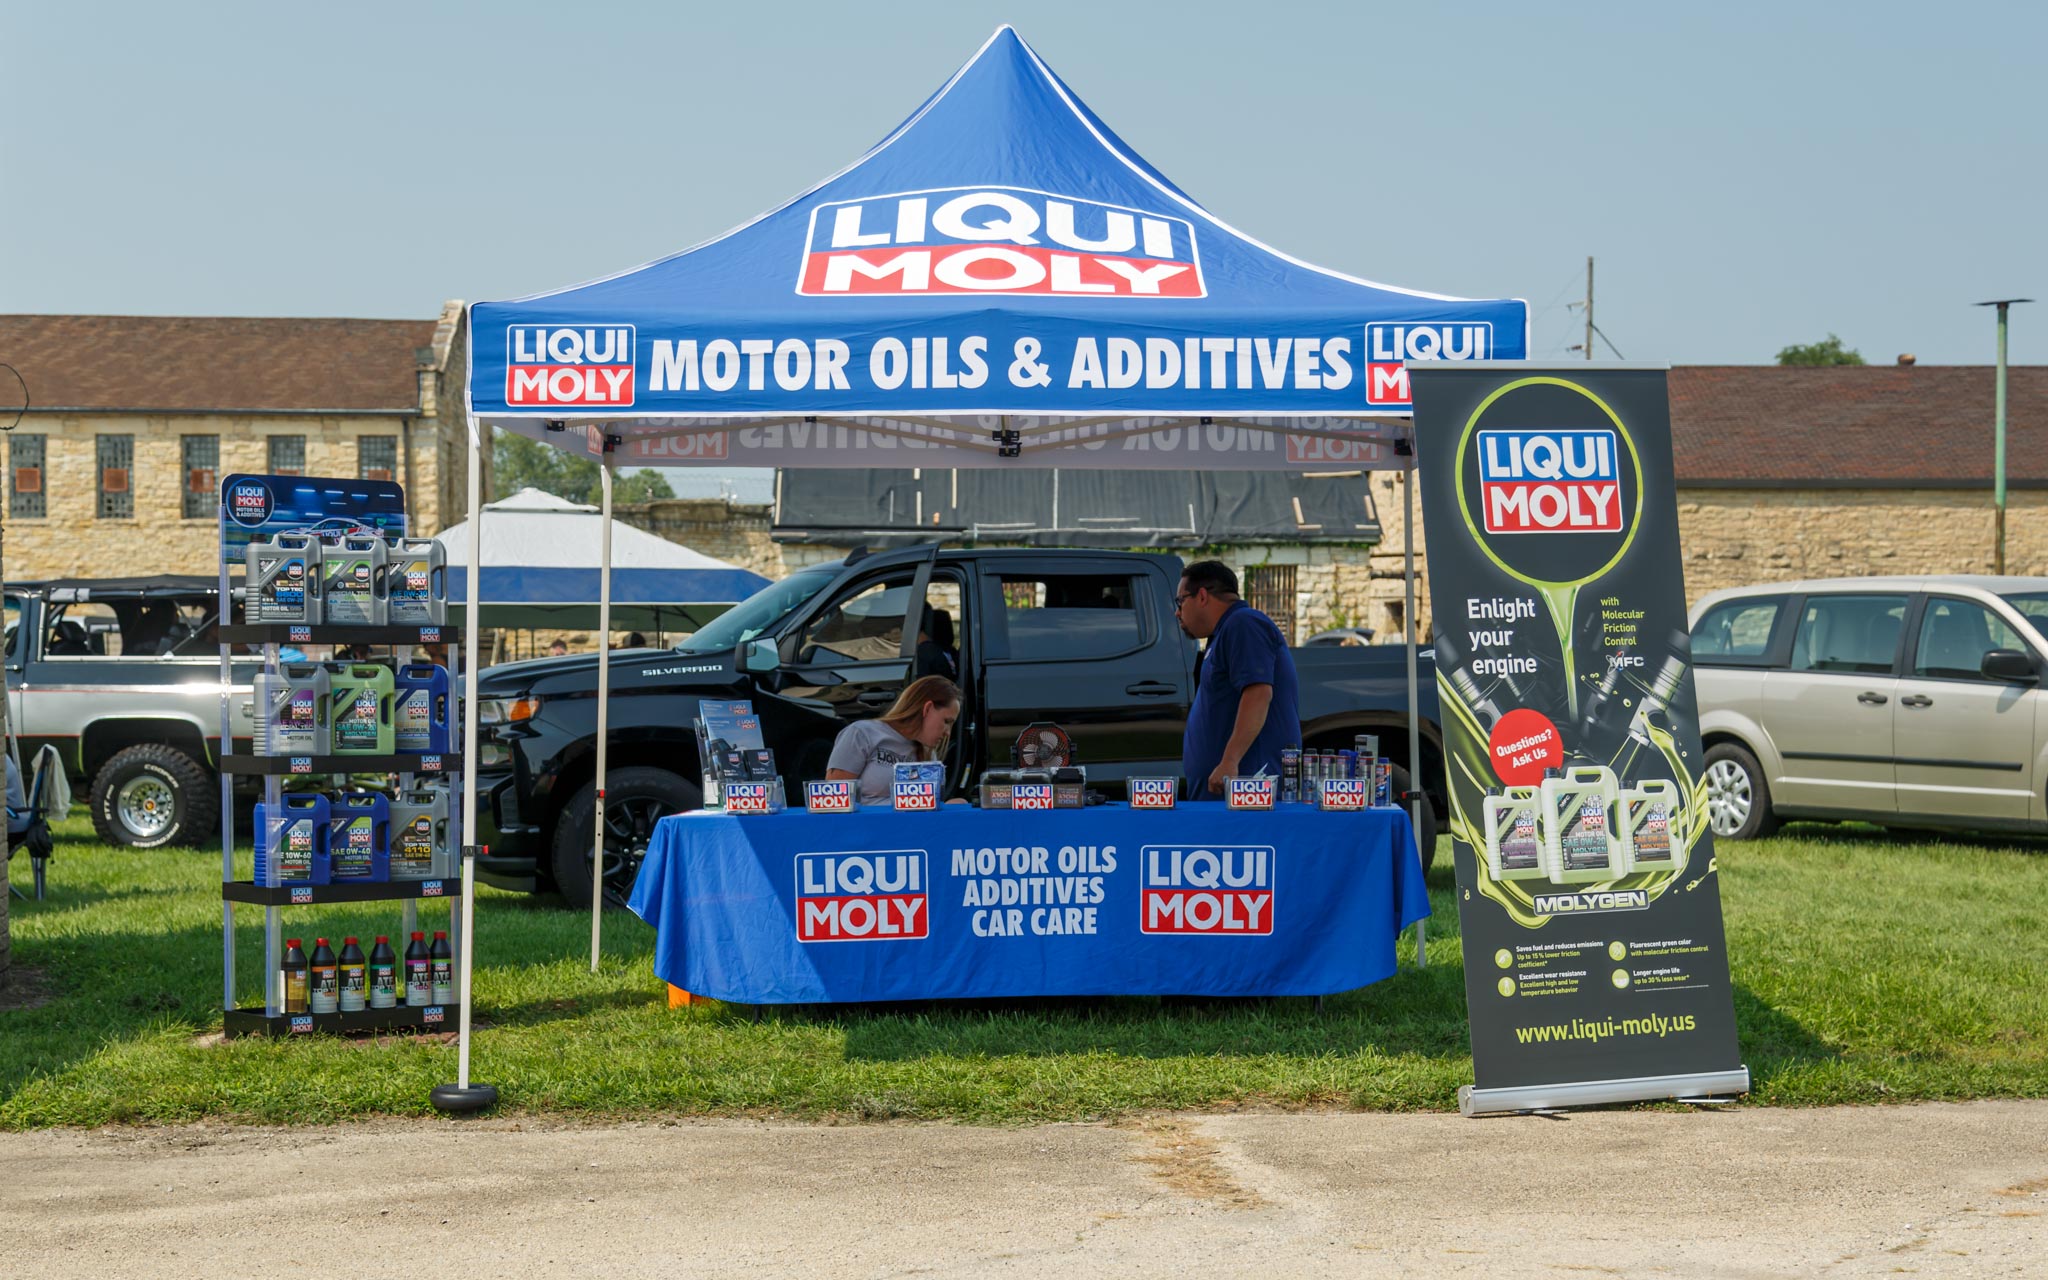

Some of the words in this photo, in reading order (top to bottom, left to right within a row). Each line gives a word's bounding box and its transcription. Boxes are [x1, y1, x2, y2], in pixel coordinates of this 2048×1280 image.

[831, 192, 1174, 258] LIQUI
[823, 247, 1189, 294] MOLY
[515, 328, 628, 365] LIQUI
[1373, 326, 1485, 361] LIQUI
[649, 338, 852, 391] MOTOR
[869, 336, 989, 391] OILS
[1008, 337, 1053, 389] &
[1067, 337, 1353, 391] ADDITIVES
[513, 367, 633, 403] MOLY
[1485, 435, 1611, 481] LIQUI
[237, 487, 264, 497] LIQUI
[237, 497, 264, 506] MOLY
[1490, 484, 1616, 528] MOLY
[407, 578, 427, 586] MOLY
[1600, 596, 1619, 606] with
[1467, 597, 1536, 623] Enlight
[1602, 609, 1645, 620] Molecular
[1603, 623, 1636, 633] Friction
[1468, 630, 1514, 651] your
[1604, 636, 1637, 646] Control
[1472, 653, 1537, 678] engine
[1609, 656, 1645, 668] MFC
[642, 664, 723, 677] SILVERADO
[1496, 728, 1553, 758] Questions?
[1511, 751, 1532, 768] Ask
[1532, 748, 1548, 761] Us
[811, 784, 847, 796] LIQU
[729, 797, 765, 809] MOLY
[812, 796, 849, 808] MOLY
[897, 796, 934, 808] MOLY
[1014, 798, 1052, 809] MOLY
[1135, 793, 1172, 805] MOLY
[1233, 793, 1271, 805] MOLY
[1326, 793, 1363, 805] MOLY
[1581, 808, 1602, 816] LIQUI
[1582, 816, 1604, 824] MOLY
[1562, 838, 1578, 847] SAE
[346, 847, 371, 855] 0W-40
[950, 847, 1049, 877] MOTOR
[1057, 845, 1118, 874] OILS
[803, 855, 920, 895] LIQUI
[1148, 850, 1267, 890] LIQUI
[423, 888, 442, 896] MOLY
[962, 876, 1105, 907] ADDITIVES
[1536, 891, 1646, 913] MOLYGEN
[804, 896, 925, 937] MOLY
[1148, 892, 1271, 931] MOLY
[971, 908, 1023, 937] CAR
[1030, 907, 1098, 936] CARE
[1555, 942, 1576, 950] reduces
[1630, 941, 1661, 949] Fluorescent
[1643, 948, 1670, 956] molecular
[1690, 945, 1709, 953] control
[1517, 953, 1525, 961] Up
[1545, 951, 1560, 959] lower
[1559, 970, 1587, 978] resistance
[1633, 970, 1652, 978] Longer
[1652, 968, 1671, 976] engine
[1545, 980, 1557, 988] high
[1520, 988, 1554, 997] temperature
[1515, 1012, 1696, 1044] www.liqui-moly.us
